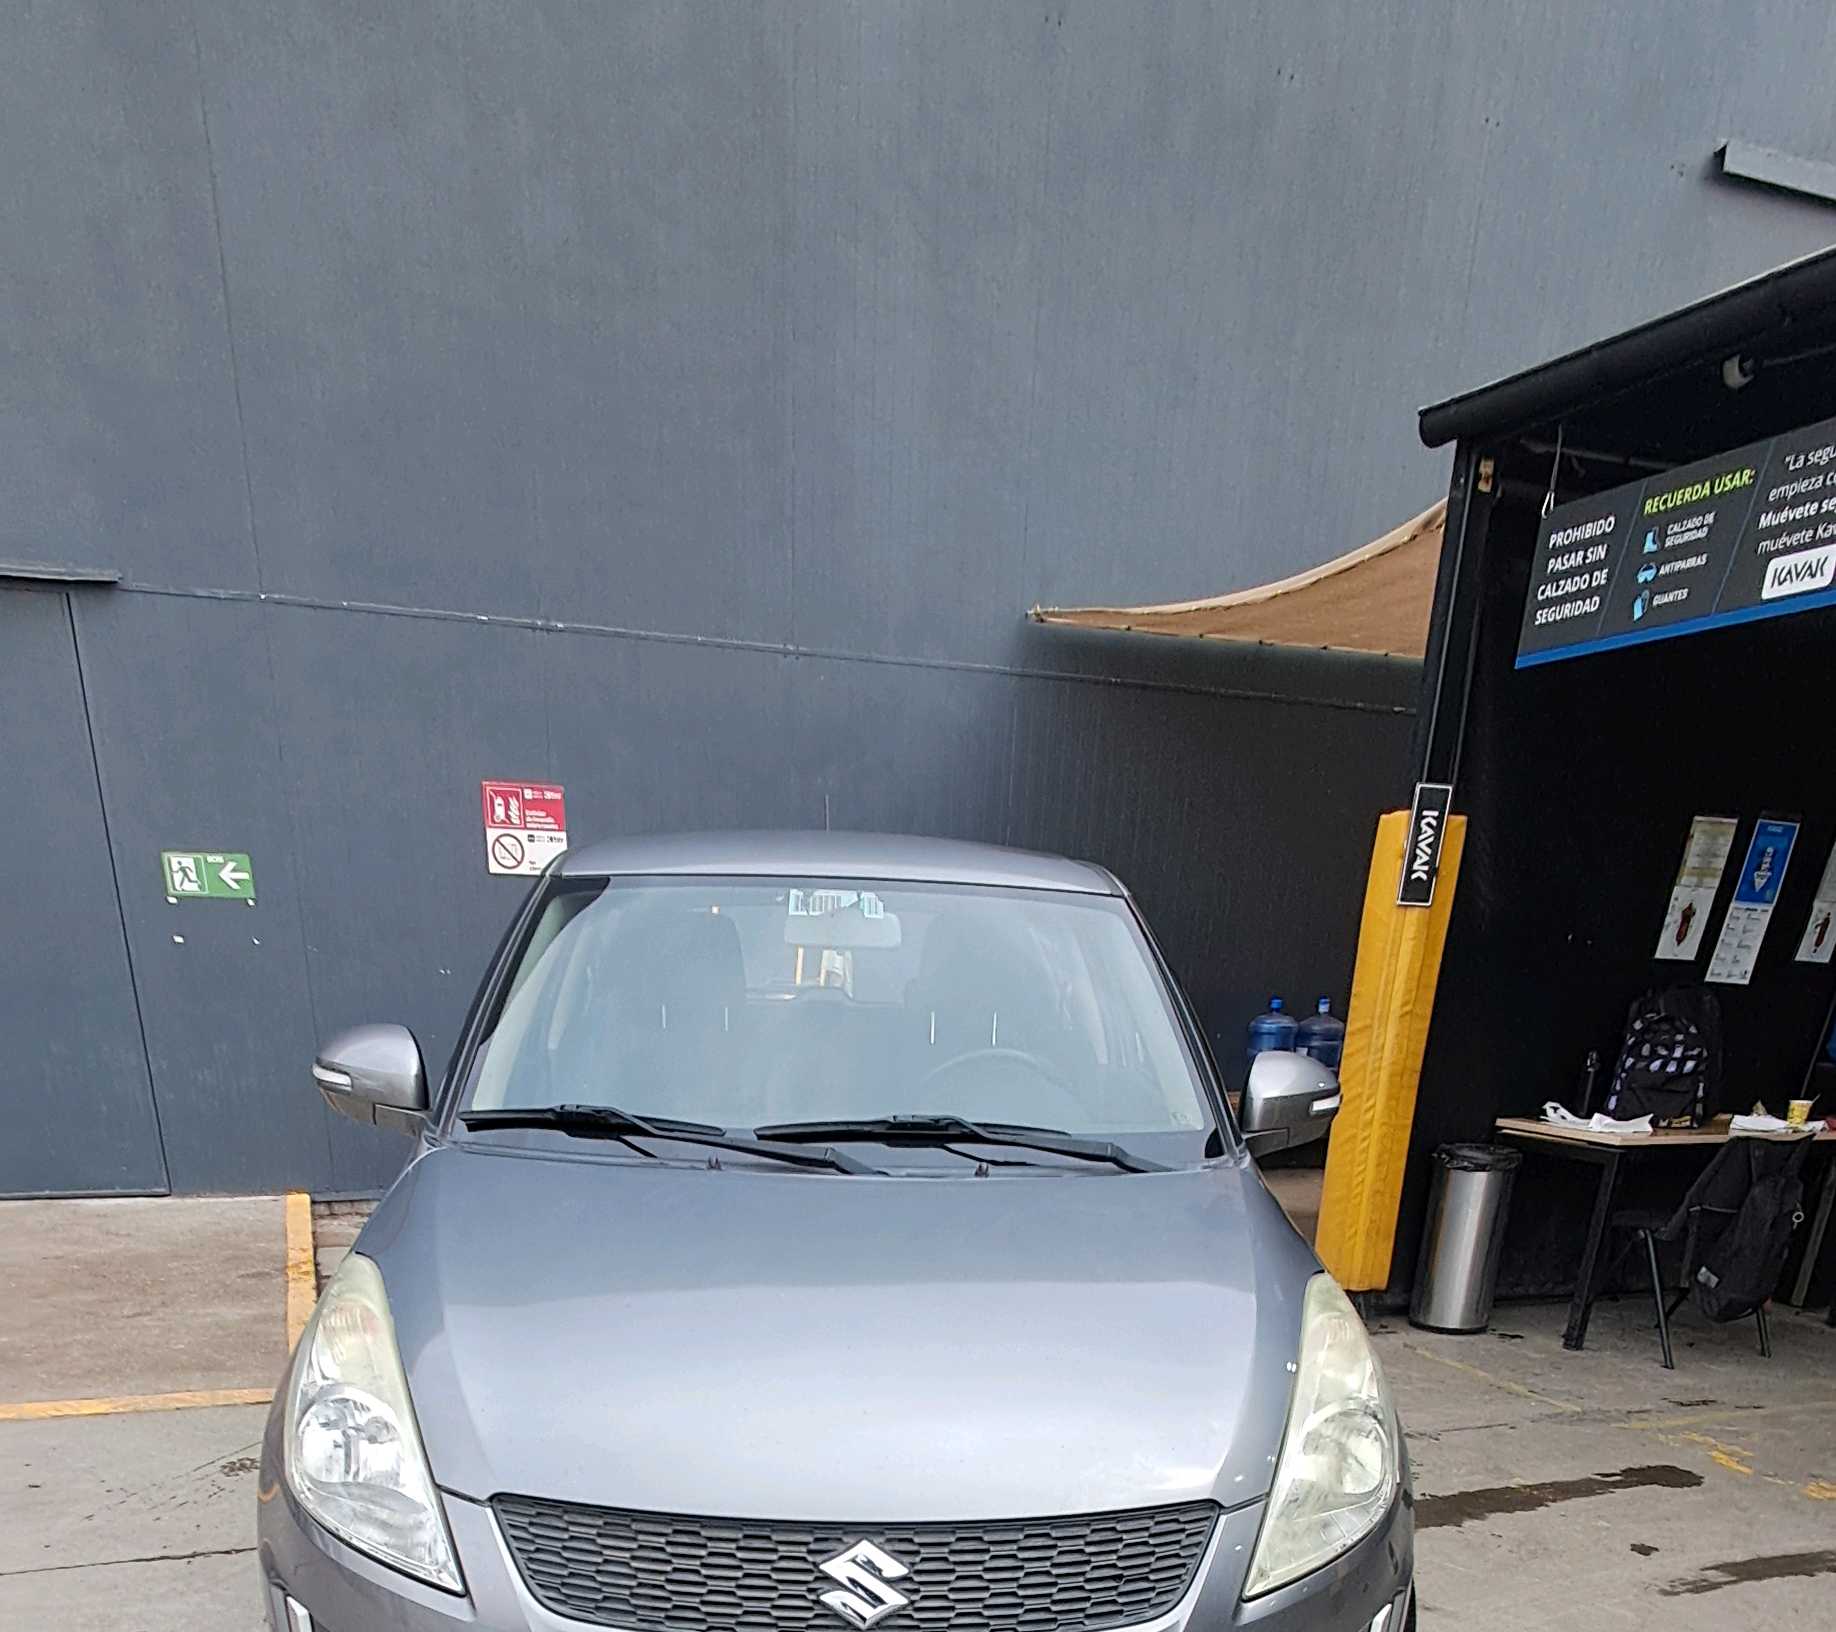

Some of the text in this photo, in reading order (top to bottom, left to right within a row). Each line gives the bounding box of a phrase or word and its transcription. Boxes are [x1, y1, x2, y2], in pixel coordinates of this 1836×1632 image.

[1644, 469, 1756, 515] RECUERDA USAR:
[1767, 475, 1823, 502] empieza
[1758, 500, 1818, 530] Muévete
[1548, 516, 1615, 549] PROHIBIDO
[1756, 530, 1814, 556] muévete
[1547, 544, 1608, 574] PASAR SIN
[1771, 555, 1829, 588] KAVAK
[1537, 568, 1609, 601] CALZADO DE
[1652, 588, 1689, 606] GUANTES
[1534, 596, 1600, 625] SEGURIDAD
[1410, 810, 1439, 881] KAVAK
